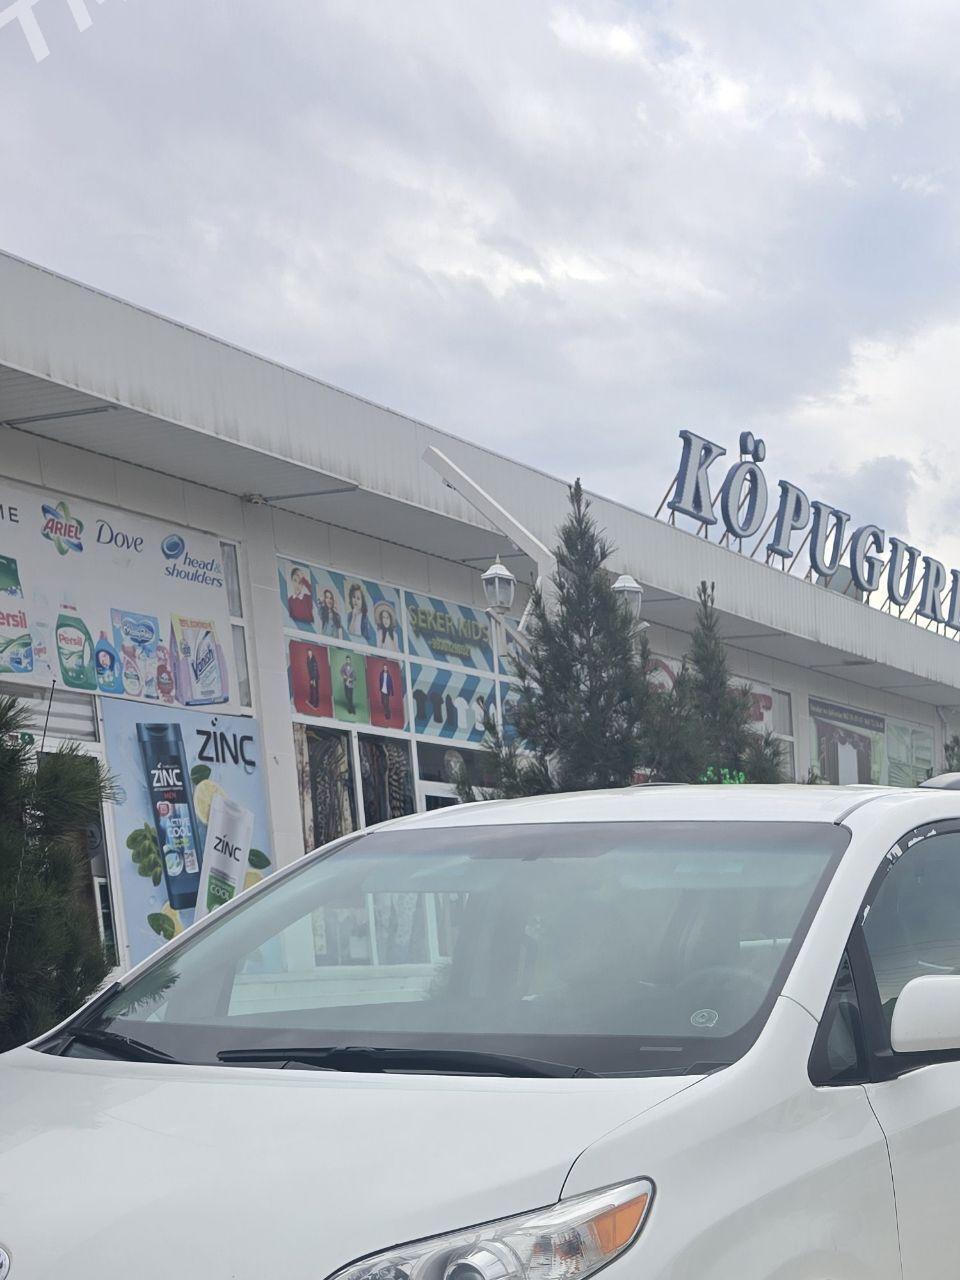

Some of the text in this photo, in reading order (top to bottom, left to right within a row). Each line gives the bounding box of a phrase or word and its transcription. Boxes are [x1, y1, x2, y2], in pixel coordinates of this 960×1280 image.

[43, 517, 81, 540] ARIEL
[96, 519, 144, 552] Dove
[165, 565, 223, 588] shoulders
